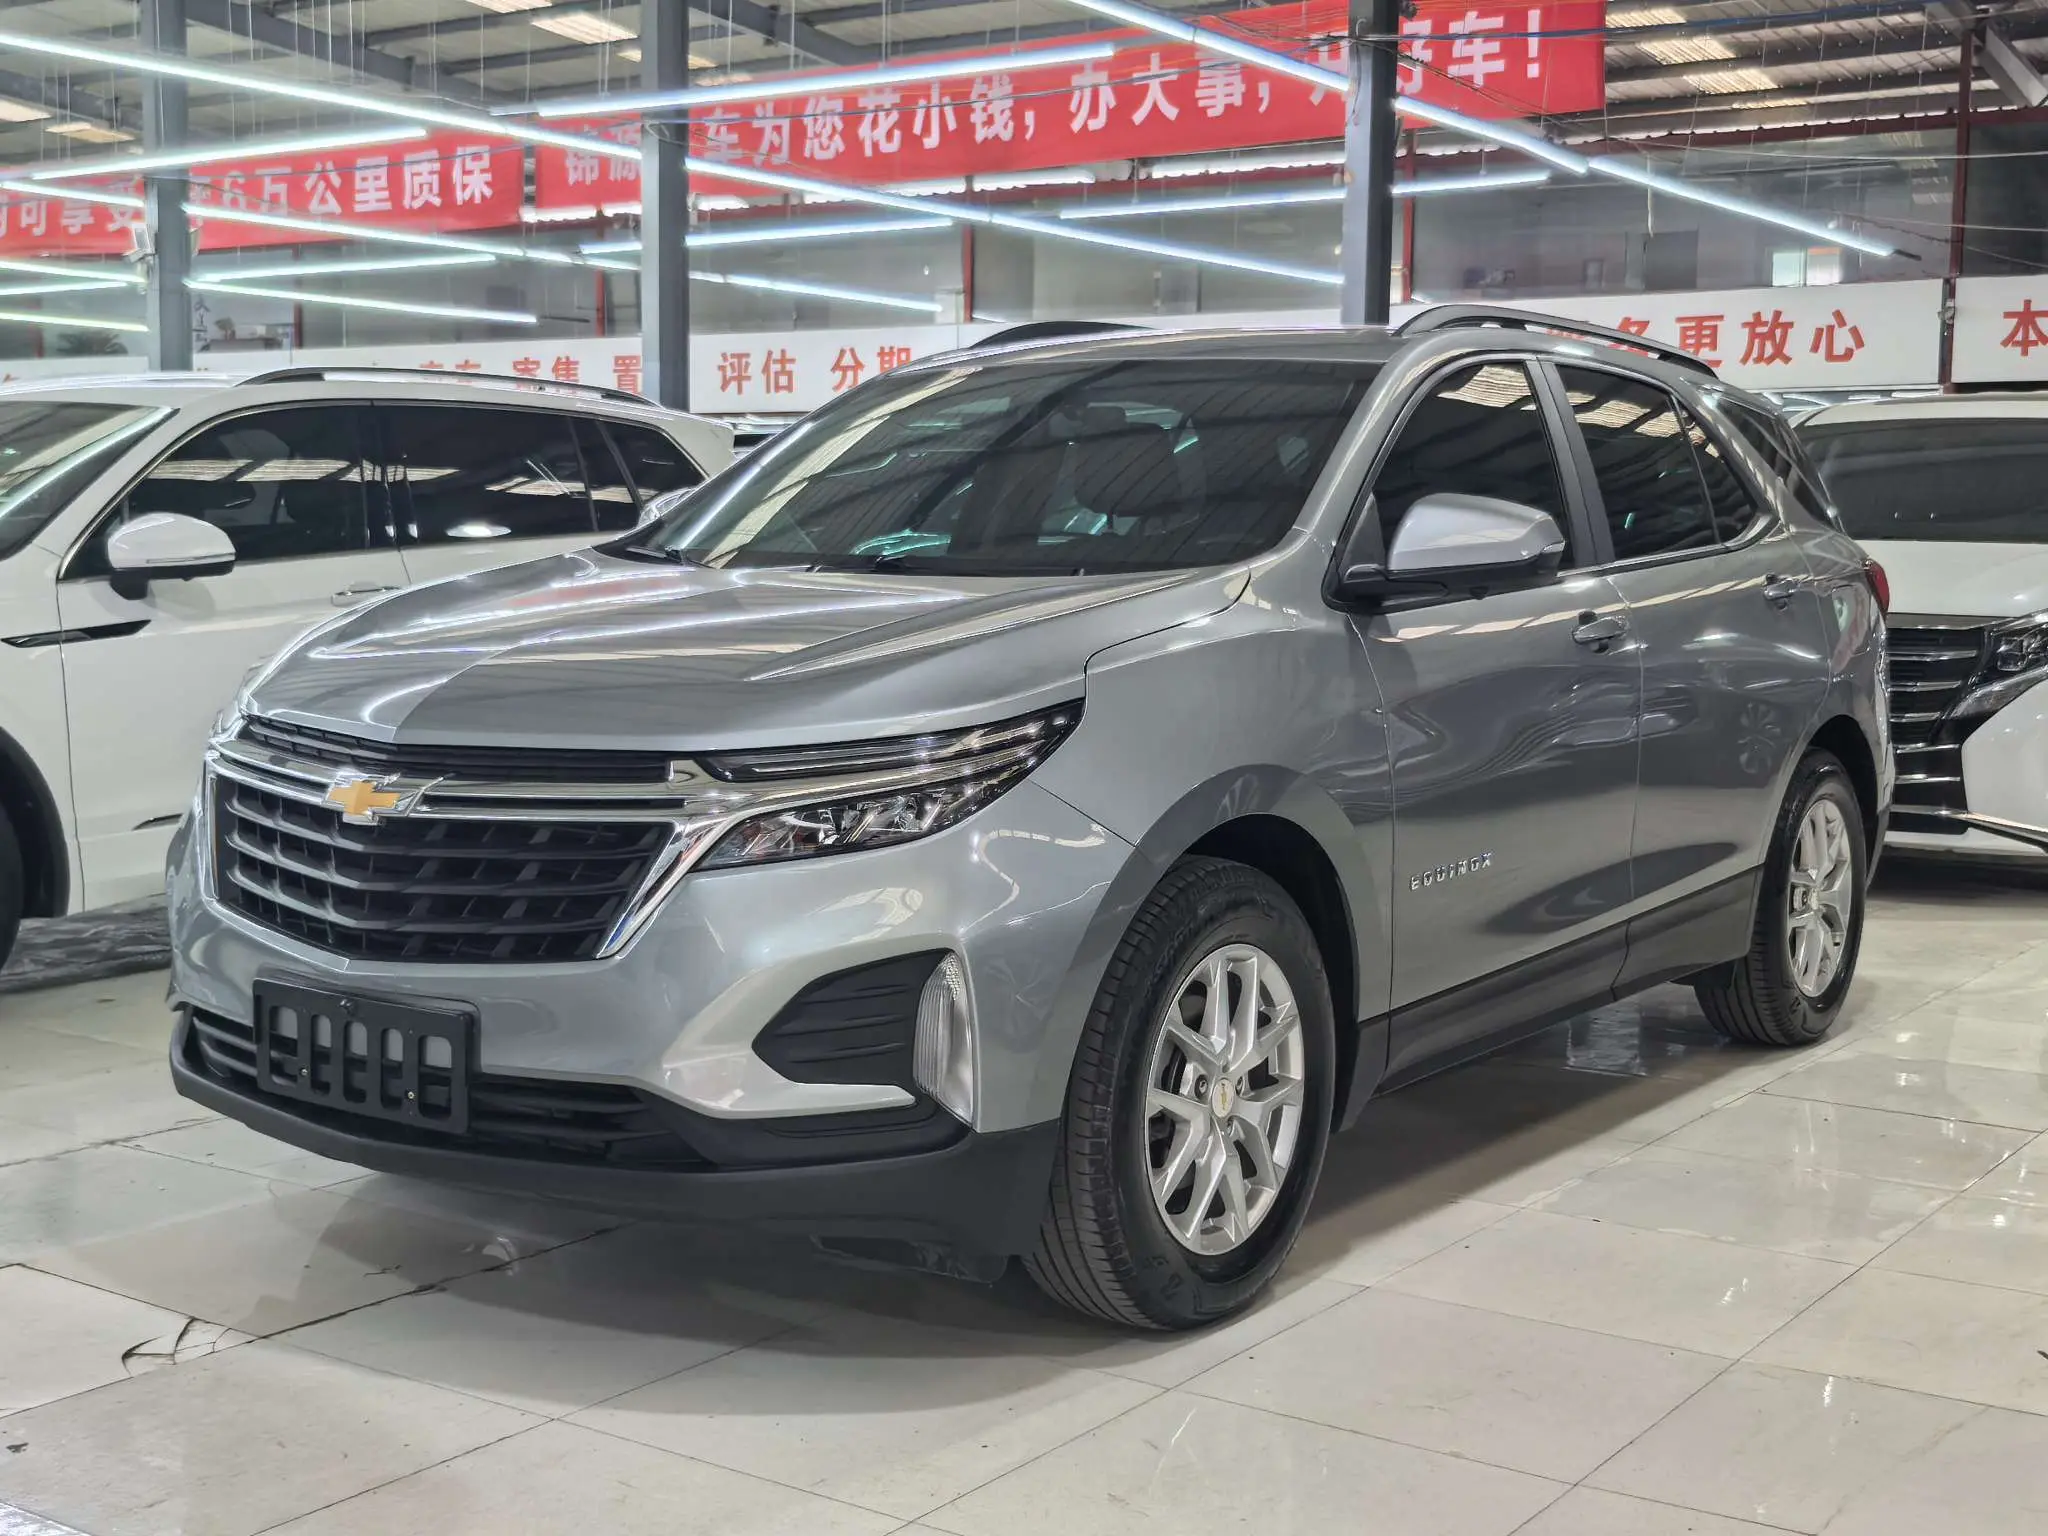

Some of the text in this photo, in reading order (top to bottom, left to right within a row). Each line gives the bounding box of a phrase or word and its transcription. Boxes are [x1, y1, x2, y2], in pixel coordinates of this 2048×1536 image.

[2000, 299, 2048, 357] 本
[717, 349, 796, 395] 评估
[1409, 852, 1493, 891] EQUINOX
